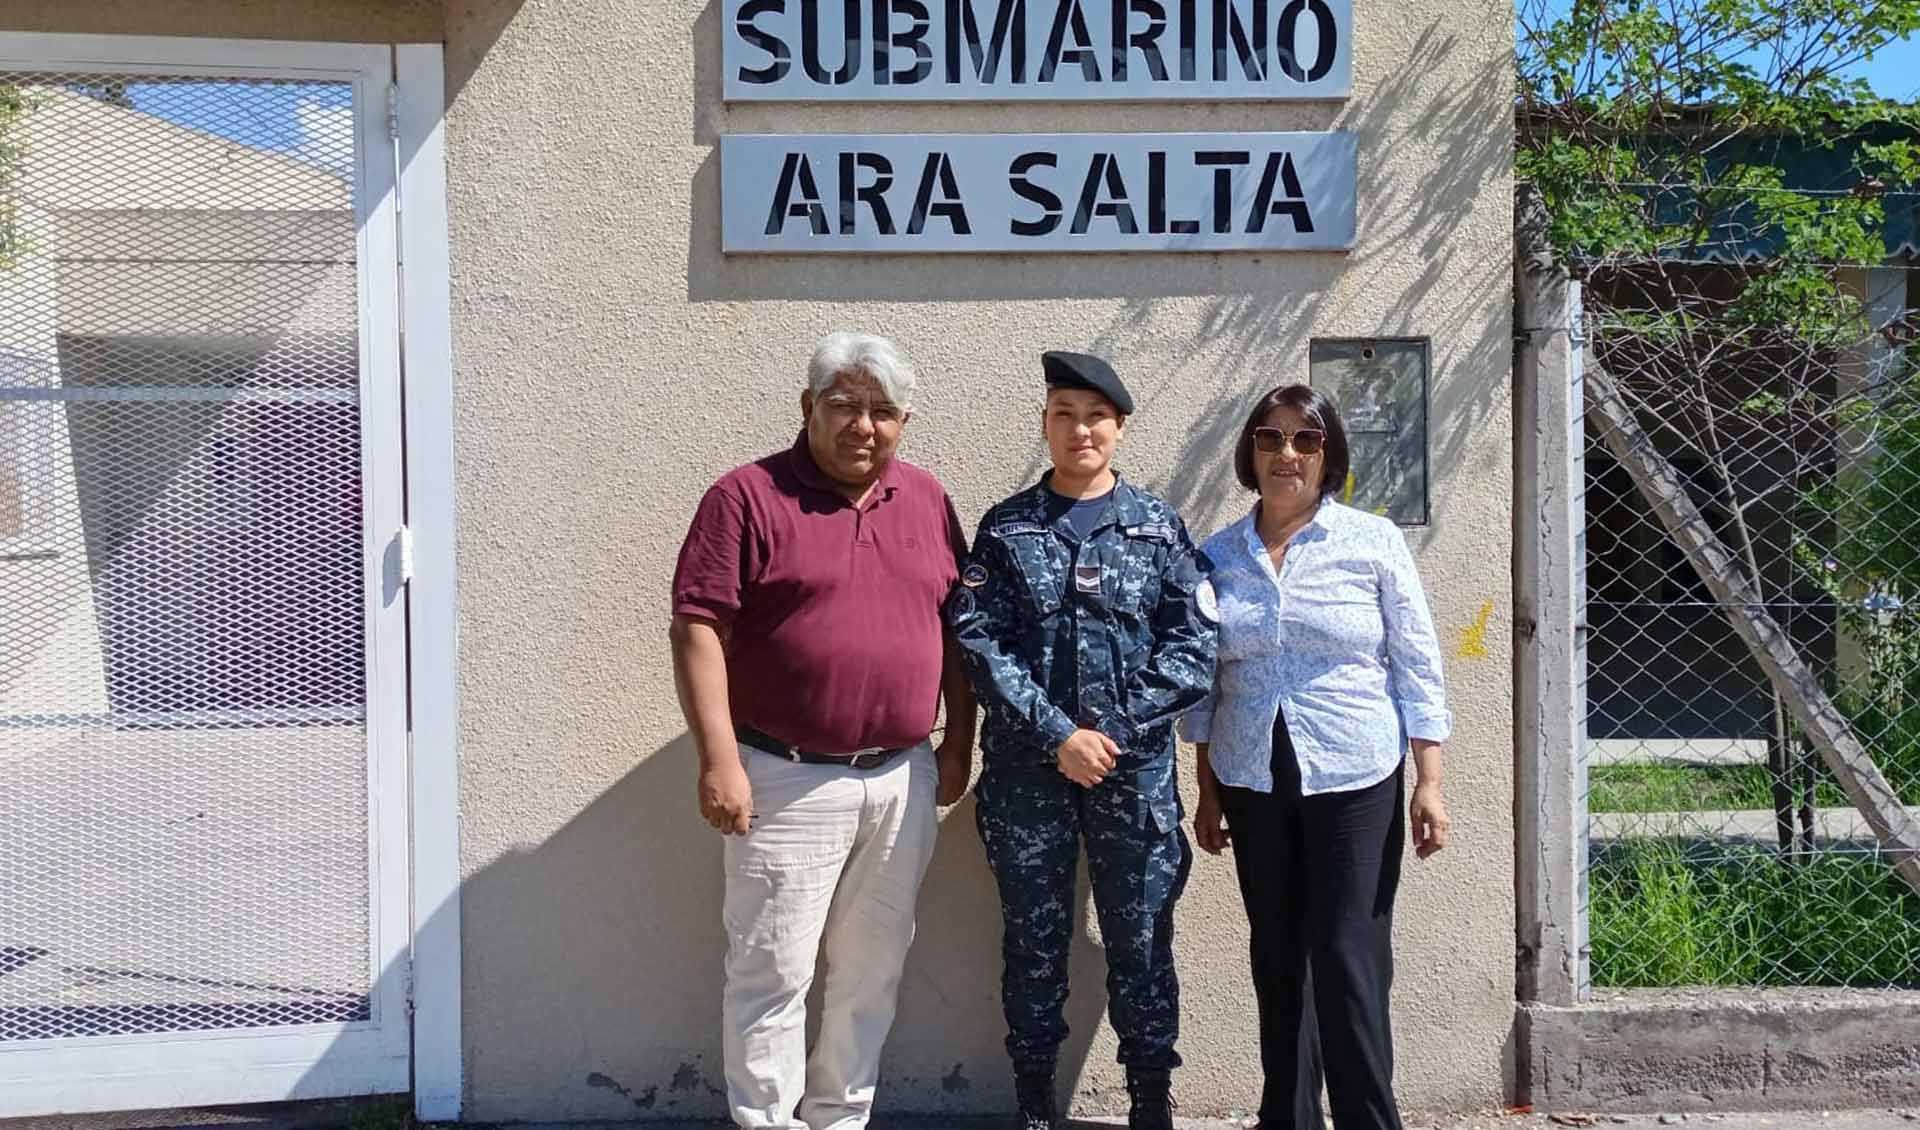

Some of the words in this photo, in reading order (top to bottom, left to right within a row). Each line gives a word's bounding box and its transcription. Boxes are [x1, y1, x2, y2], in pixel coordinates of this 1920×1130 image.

[735, 0, 1338, 86] SUBMARINO
[764, 152, 972, 236] ARA
[1008, 151, 1316, 237] SALTA
